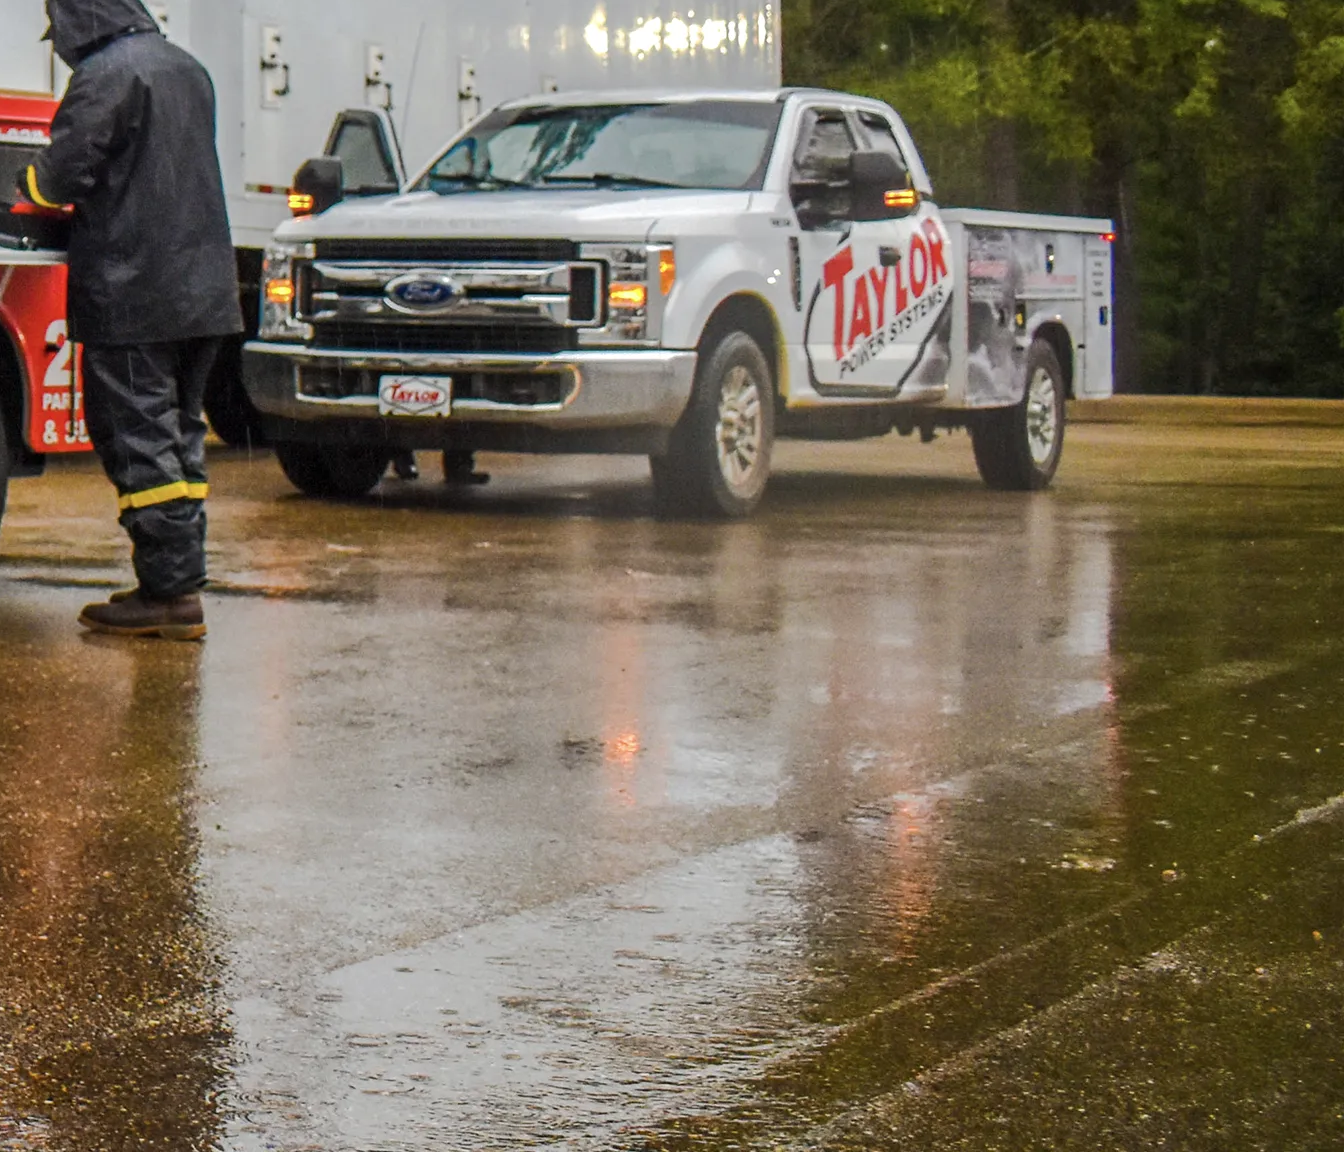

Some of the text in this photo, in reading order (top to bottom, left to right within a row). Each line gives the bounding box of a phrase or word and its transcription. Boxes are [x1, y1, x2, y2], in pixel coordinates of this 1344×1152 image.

[823, 218, 948, 362] TAYLOR
[839, 284, 944, 380] POWER SYSTEMS
[391, 384, 440, 402] TAYLOR
[42, 419, 59, 444] &
